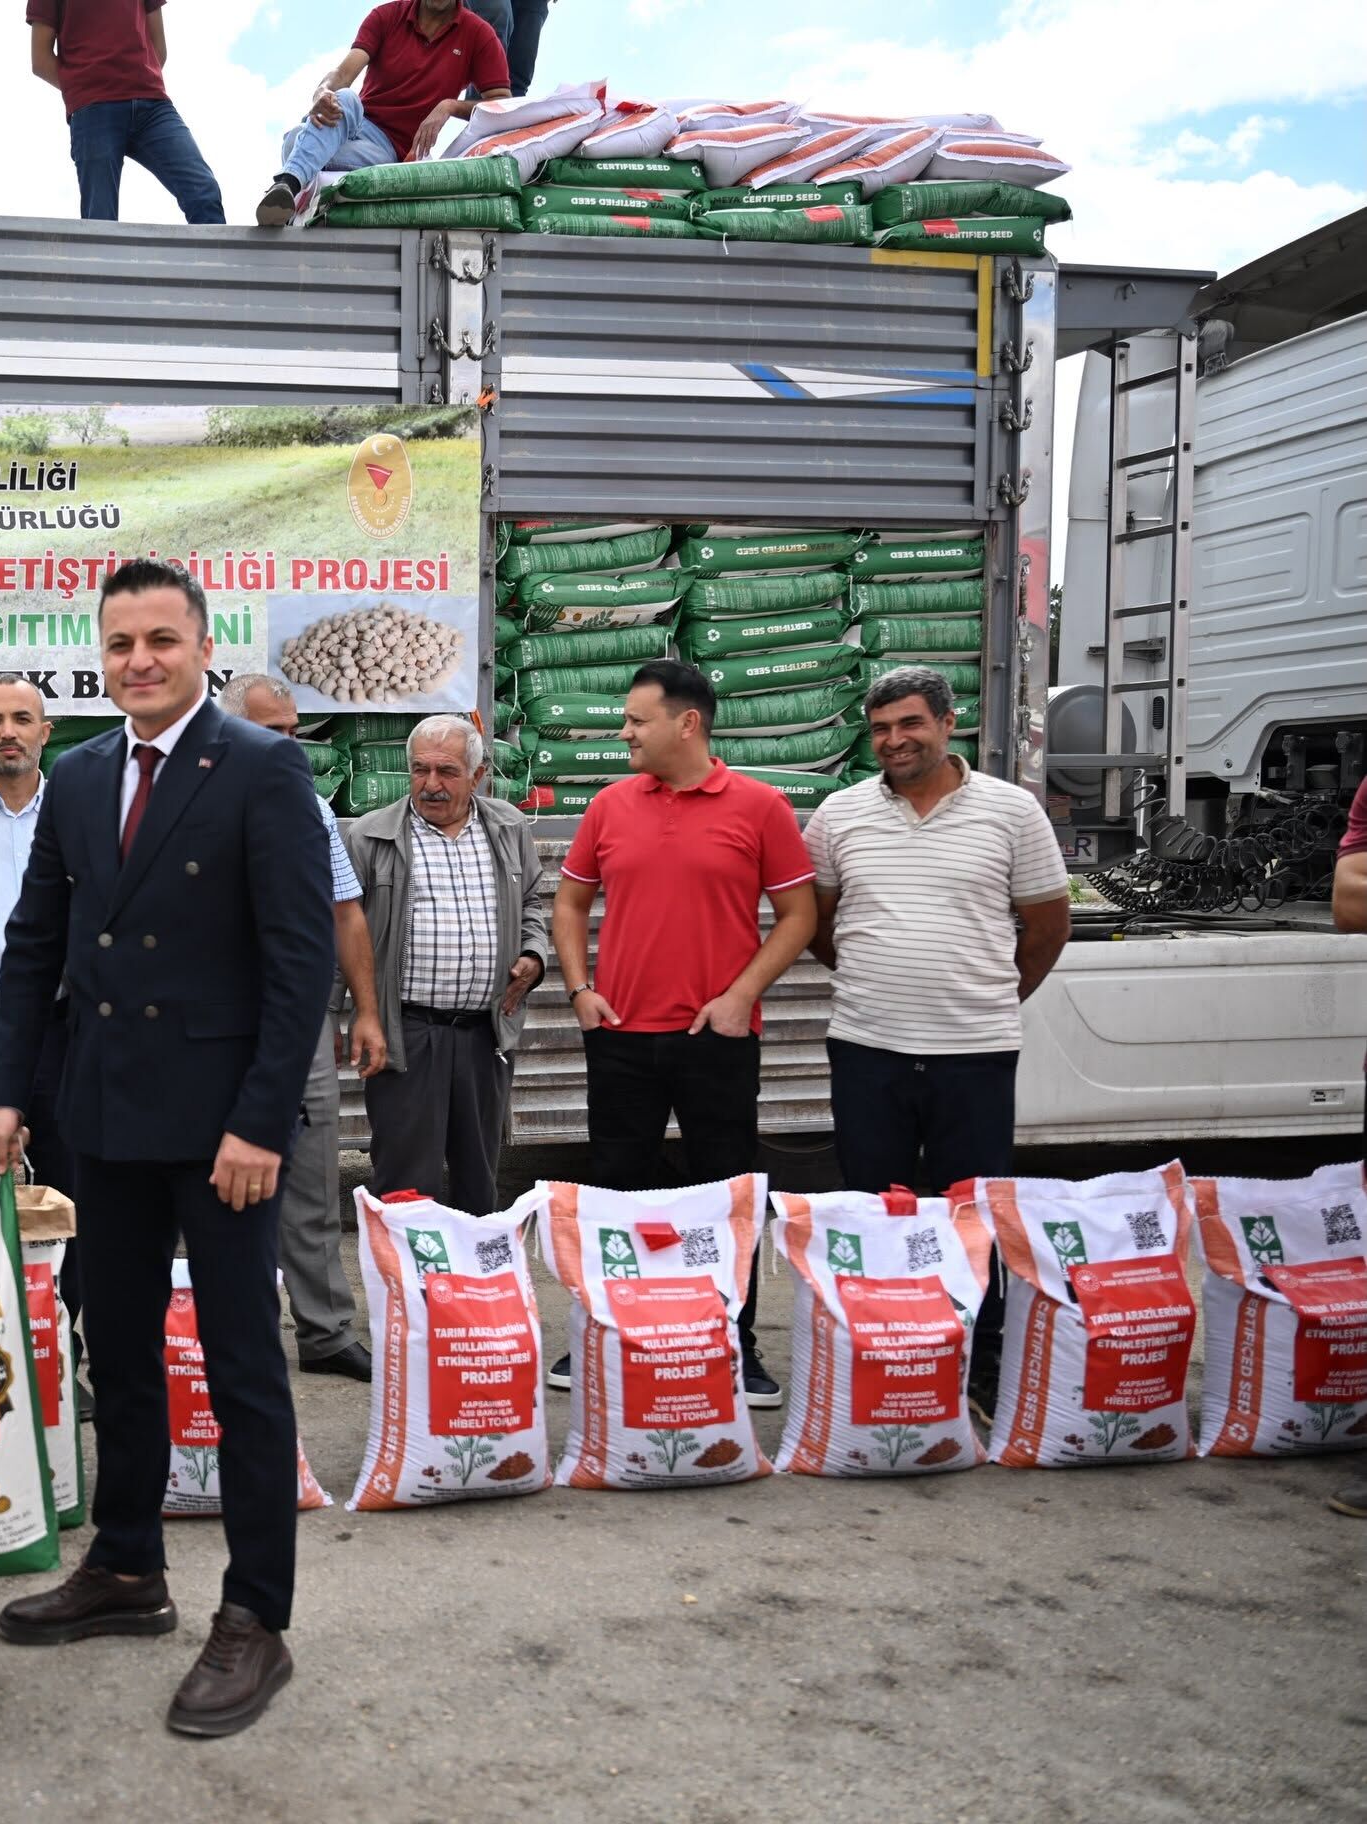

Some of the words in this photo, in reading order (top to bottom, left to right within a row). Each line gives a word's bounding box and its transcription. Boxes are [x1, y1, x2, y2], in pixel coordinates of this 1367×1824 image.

[598, 199, 647, 208] CERTIFIED
[743, 195, 794, 203] CERTIFIED
[736, 547, 760, 555] SEED
[762, 544, 808, 554] CERTIFIED
[890, 550, 914, 558] SEED
[916, 549, 963, 557] CERTIFIED
[291, 552, 449, 592] PROJESİ
[742, 628, 765, 636] SEED
[767, 622, 812, 634] CERTIFIED
[746, 667, 771, 676] SEED
[772, 660, 818, 673] CERTIFIED
[576, 752, 600, 760] SEED
[1090, 1313, 1123, 1325] TARIM
[434, 1328, 466, 1338] TARIM
[1330, 1342, 1367, 1355] PROJE
[1121, 1348, 1168, 1365] PROJESİ
[655, 1363, 707, 1380] PROJESİ
[885, 1361, 937, 1376] PROJESİ
[461, 1369, 513, 1384] PROJESİ
[1315, 1386, 1352, 1396] HİBELİ
[1104, 1394, 1141, 1405] HİBELİ
[643, 1412, 680, 1423] HİBELİ
[683, 1409, 719, 1421] TOHUM
[871, 1407, 908, 1418] HİBELİ
[450, 1417, 486, 1429] HİBELİ
[182, 1427, 218, 1439] HİBELİ
